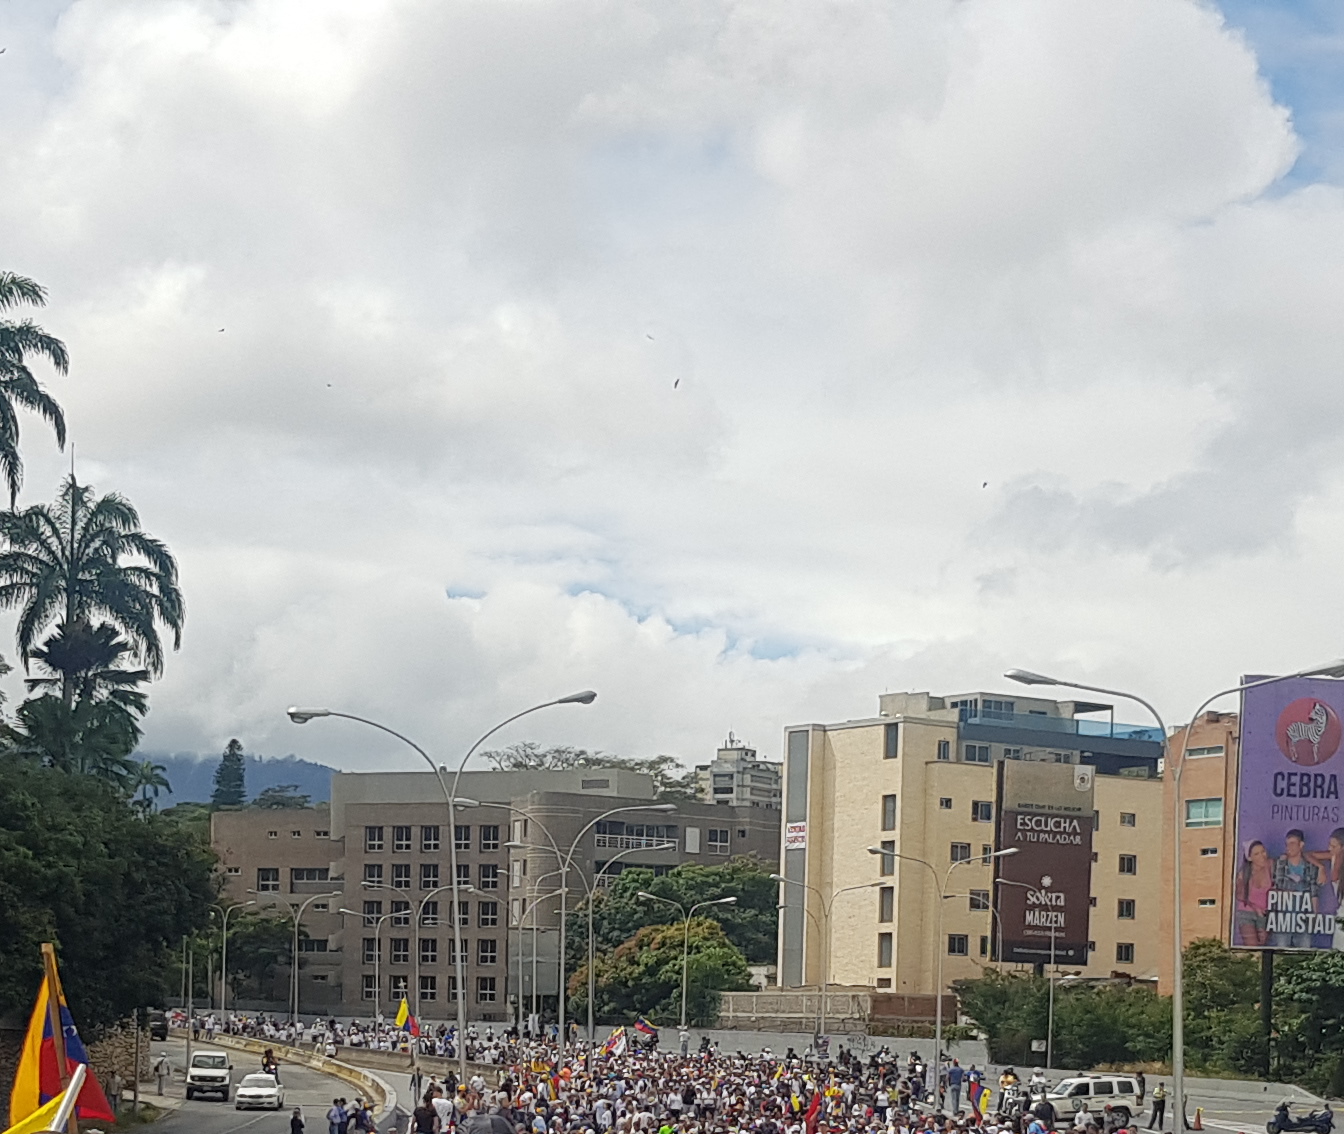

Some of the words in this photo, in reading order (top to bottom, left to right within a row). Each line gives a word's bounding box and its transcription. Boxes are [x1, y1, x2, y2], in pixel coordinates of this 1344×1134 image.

[1272, 771, 1339, 799] CEBRA
[1271, 804, 1339, 823] PINTURAS
[1016, 815, 1081, 833] ESCUCHA
[1015, 831, 1023, 841] A
[1026, 832, 1037, 842] TU
[1039, 833, 1082, 845] PALADAR
[1267, 890, 1312, 912] PINTA
[1266, 912, 1335, 934] AMISTAD
